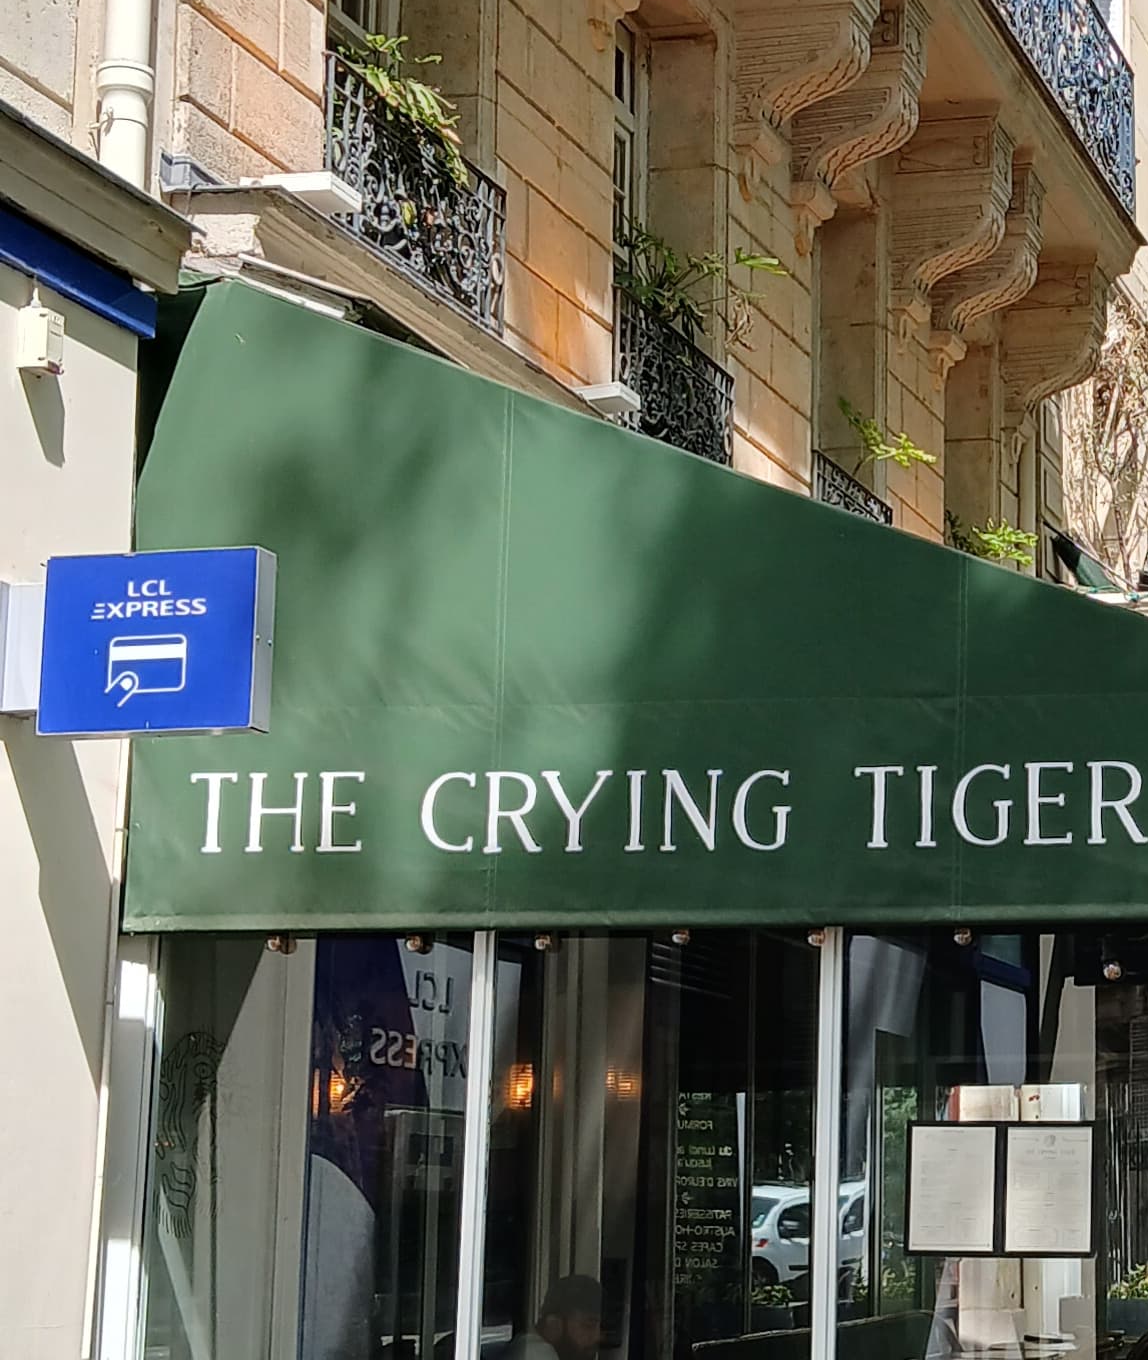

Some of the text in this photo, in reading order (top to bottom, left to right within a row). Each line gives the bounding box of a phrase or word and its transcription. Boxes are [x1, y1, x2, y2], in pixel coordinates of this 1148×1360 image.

[127, 579, 172, 597] LCL
[90, 597, 207, 620] EXPRESS
[190, 760, 1148, 853] THE CRYING TIGER
